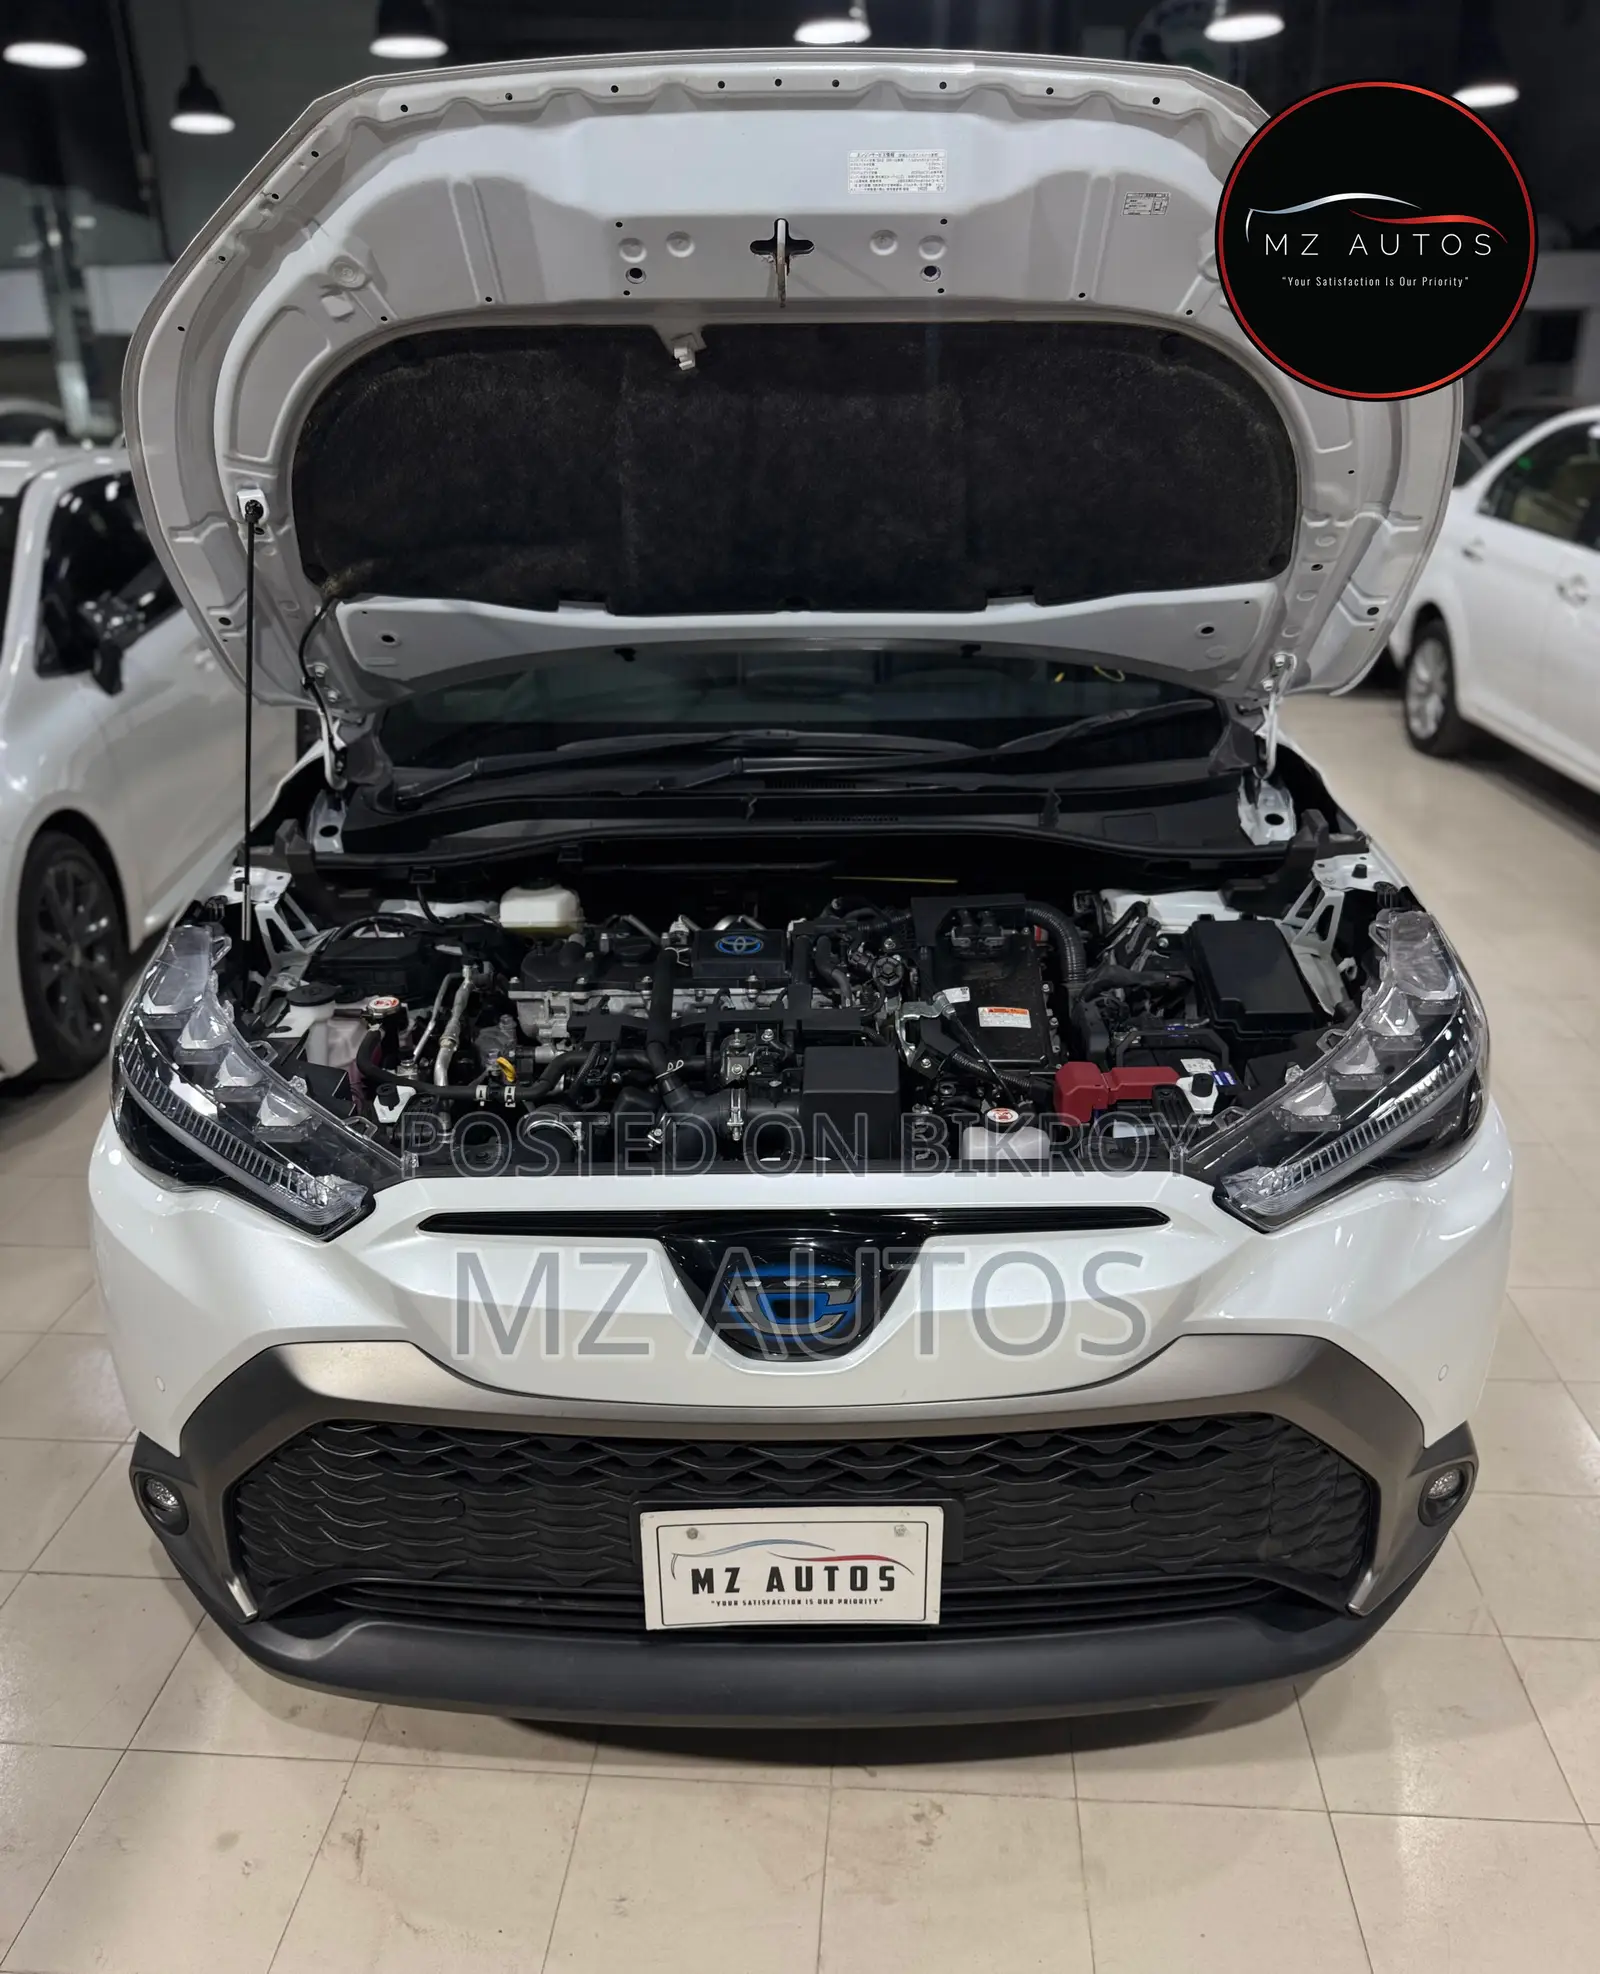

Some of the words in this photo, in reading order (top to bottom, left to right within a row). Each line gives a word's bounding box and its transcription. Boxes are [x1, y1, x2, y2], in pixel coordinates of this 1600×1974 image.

[690, 1566, 741, 1595] MZ
[765, 1565, 895, 1593] AUTOS
[742, 1598, 802, 1606] SATISFACTION
